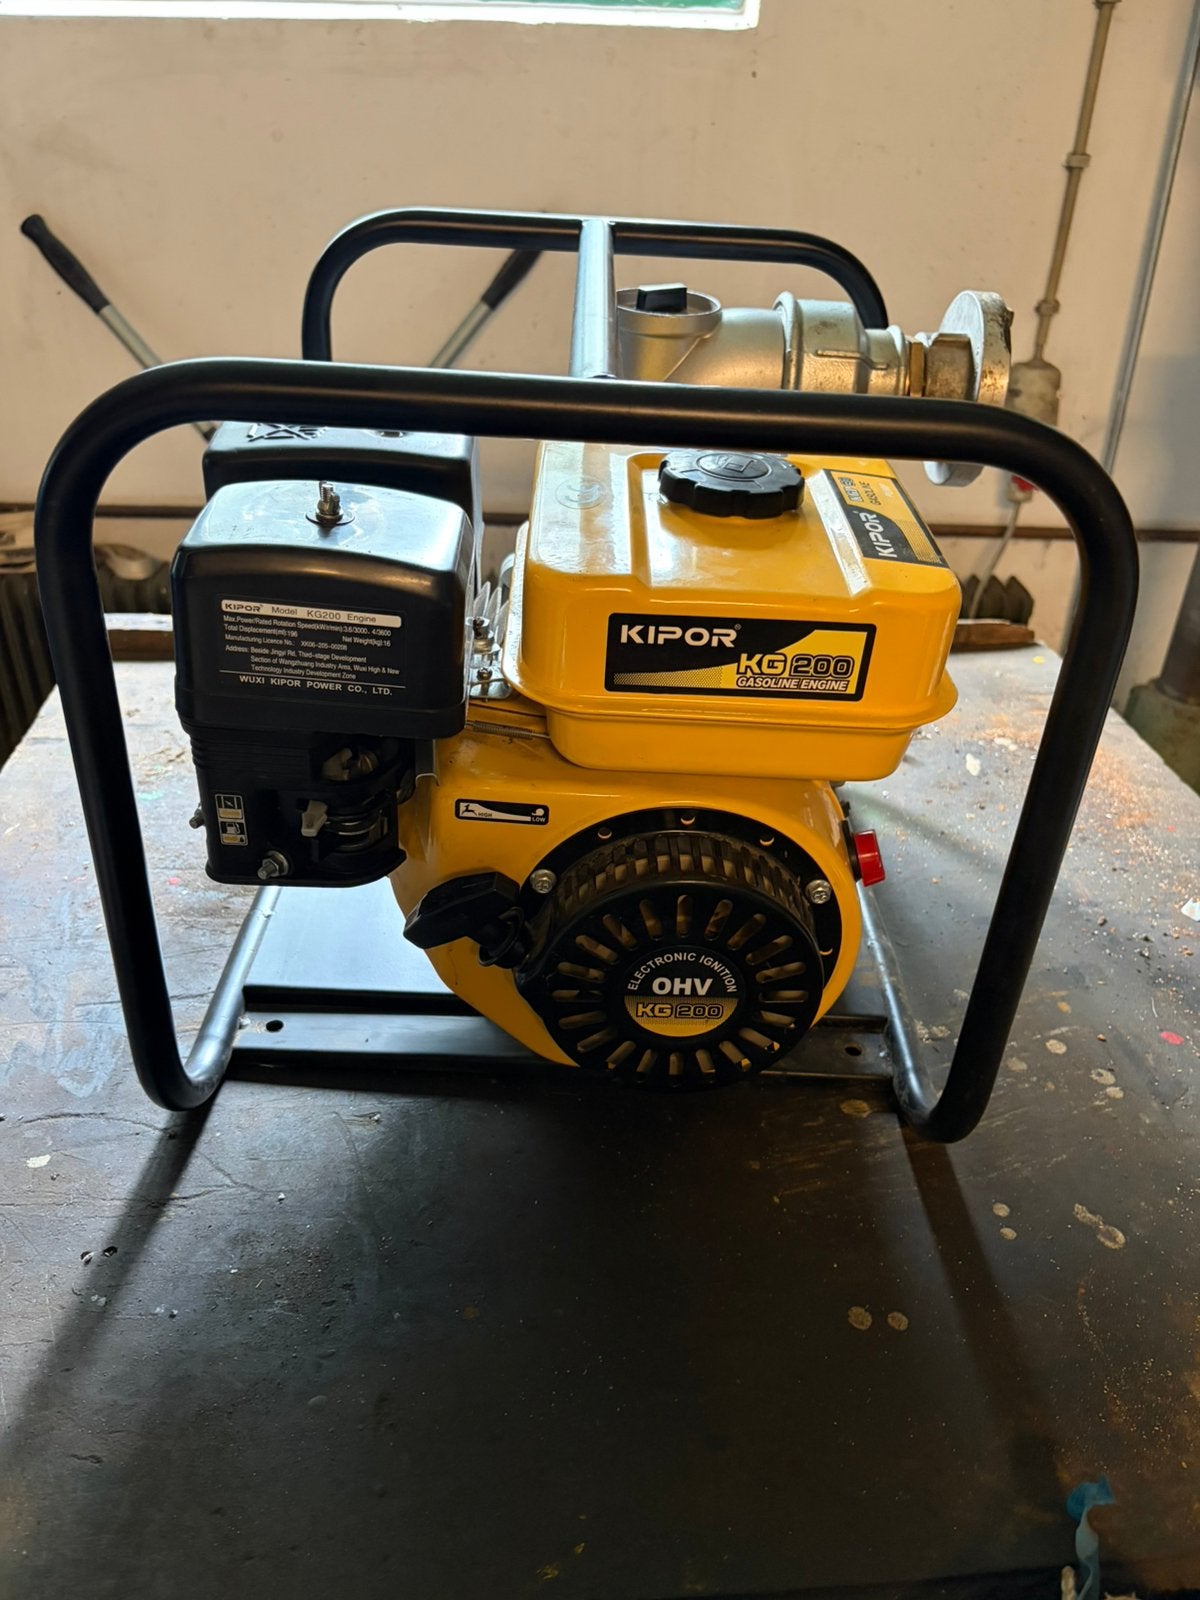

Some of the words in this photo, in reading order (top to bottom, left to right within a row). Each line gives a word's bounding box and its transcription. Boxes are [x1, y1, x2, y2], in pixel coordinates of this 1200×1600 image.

[859, 512, 898, 558] KIPOR
[225, 603, 261, 612] KIPOR
[271, 606, 298, 615] Model
[307, 609, 341, 620] KG200
[347, 613, 377, 624] Engine
[272, 619, 297, 628] Rotation
[224, 623, 238, 632] Total
[620, 624, 738, 648] KIPOR
[225, 633, 262, 645] Manufacturing
[250, 646, 270, 655] Beside
[331, 653, 367, 664] Development
[737, 651, 788, 675] KG
[791, 654, 855, 678] 200
[250, 655, 272, 663] Section
[315, 661, 337, 671] Industry
[353, 665, 368, 673] Wuxi
[368, 666, 381, 675] High
[387, 668, 401, 676] New
[250, 664, 282, 674] Technology
[283, 667, 305, 677] Industry
[305, 669, 341, 679] Development
[341, 672, 357, 680] Zone
[239, 675, 265, 685] WUXI
[270, 678, 302, 688] KIPOR
[306, 681, 343, 692] POWER
[347, 684, 368, 695] CO.,
[372, 687, 393, 697] LTD.
[736, 677, 799, 689] GASOLINE
[800, 679, 849, 691] ENGINE
[627, 952, 697, 991] ELECTRONIC
[699, 954, 738, 993] IGNITION
[652, 976, 714, 996] OHV
[635, 1002, 673, 1018] KG
[674, 1004, 723, 1019] 200
